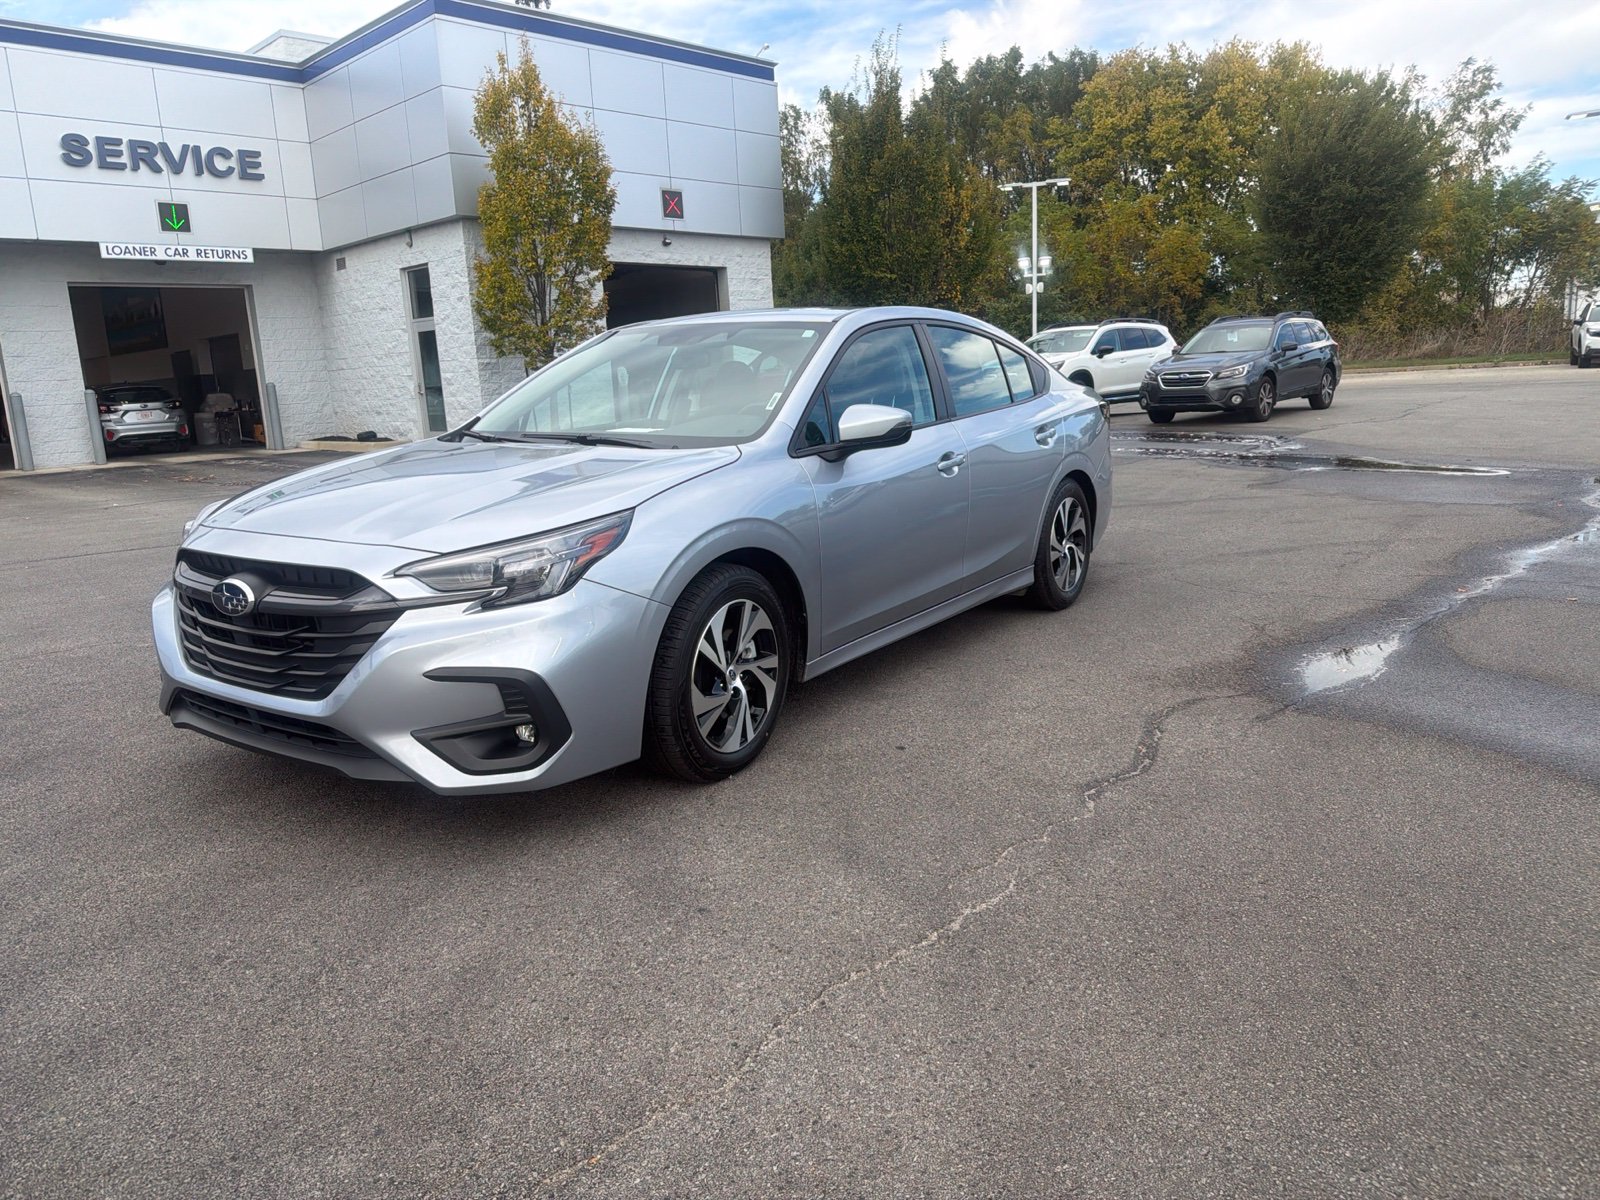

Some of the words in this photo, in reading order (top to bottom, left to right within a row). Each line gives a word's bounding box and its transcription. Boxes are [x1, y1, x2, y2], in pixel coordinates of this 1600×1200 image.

[60, 132, 265, 181] SERVICE
[105, 245, 157, 257] LOANER
[164, 247, 189, 258] CAR
[196, 248, 248, 260] RETURNS
